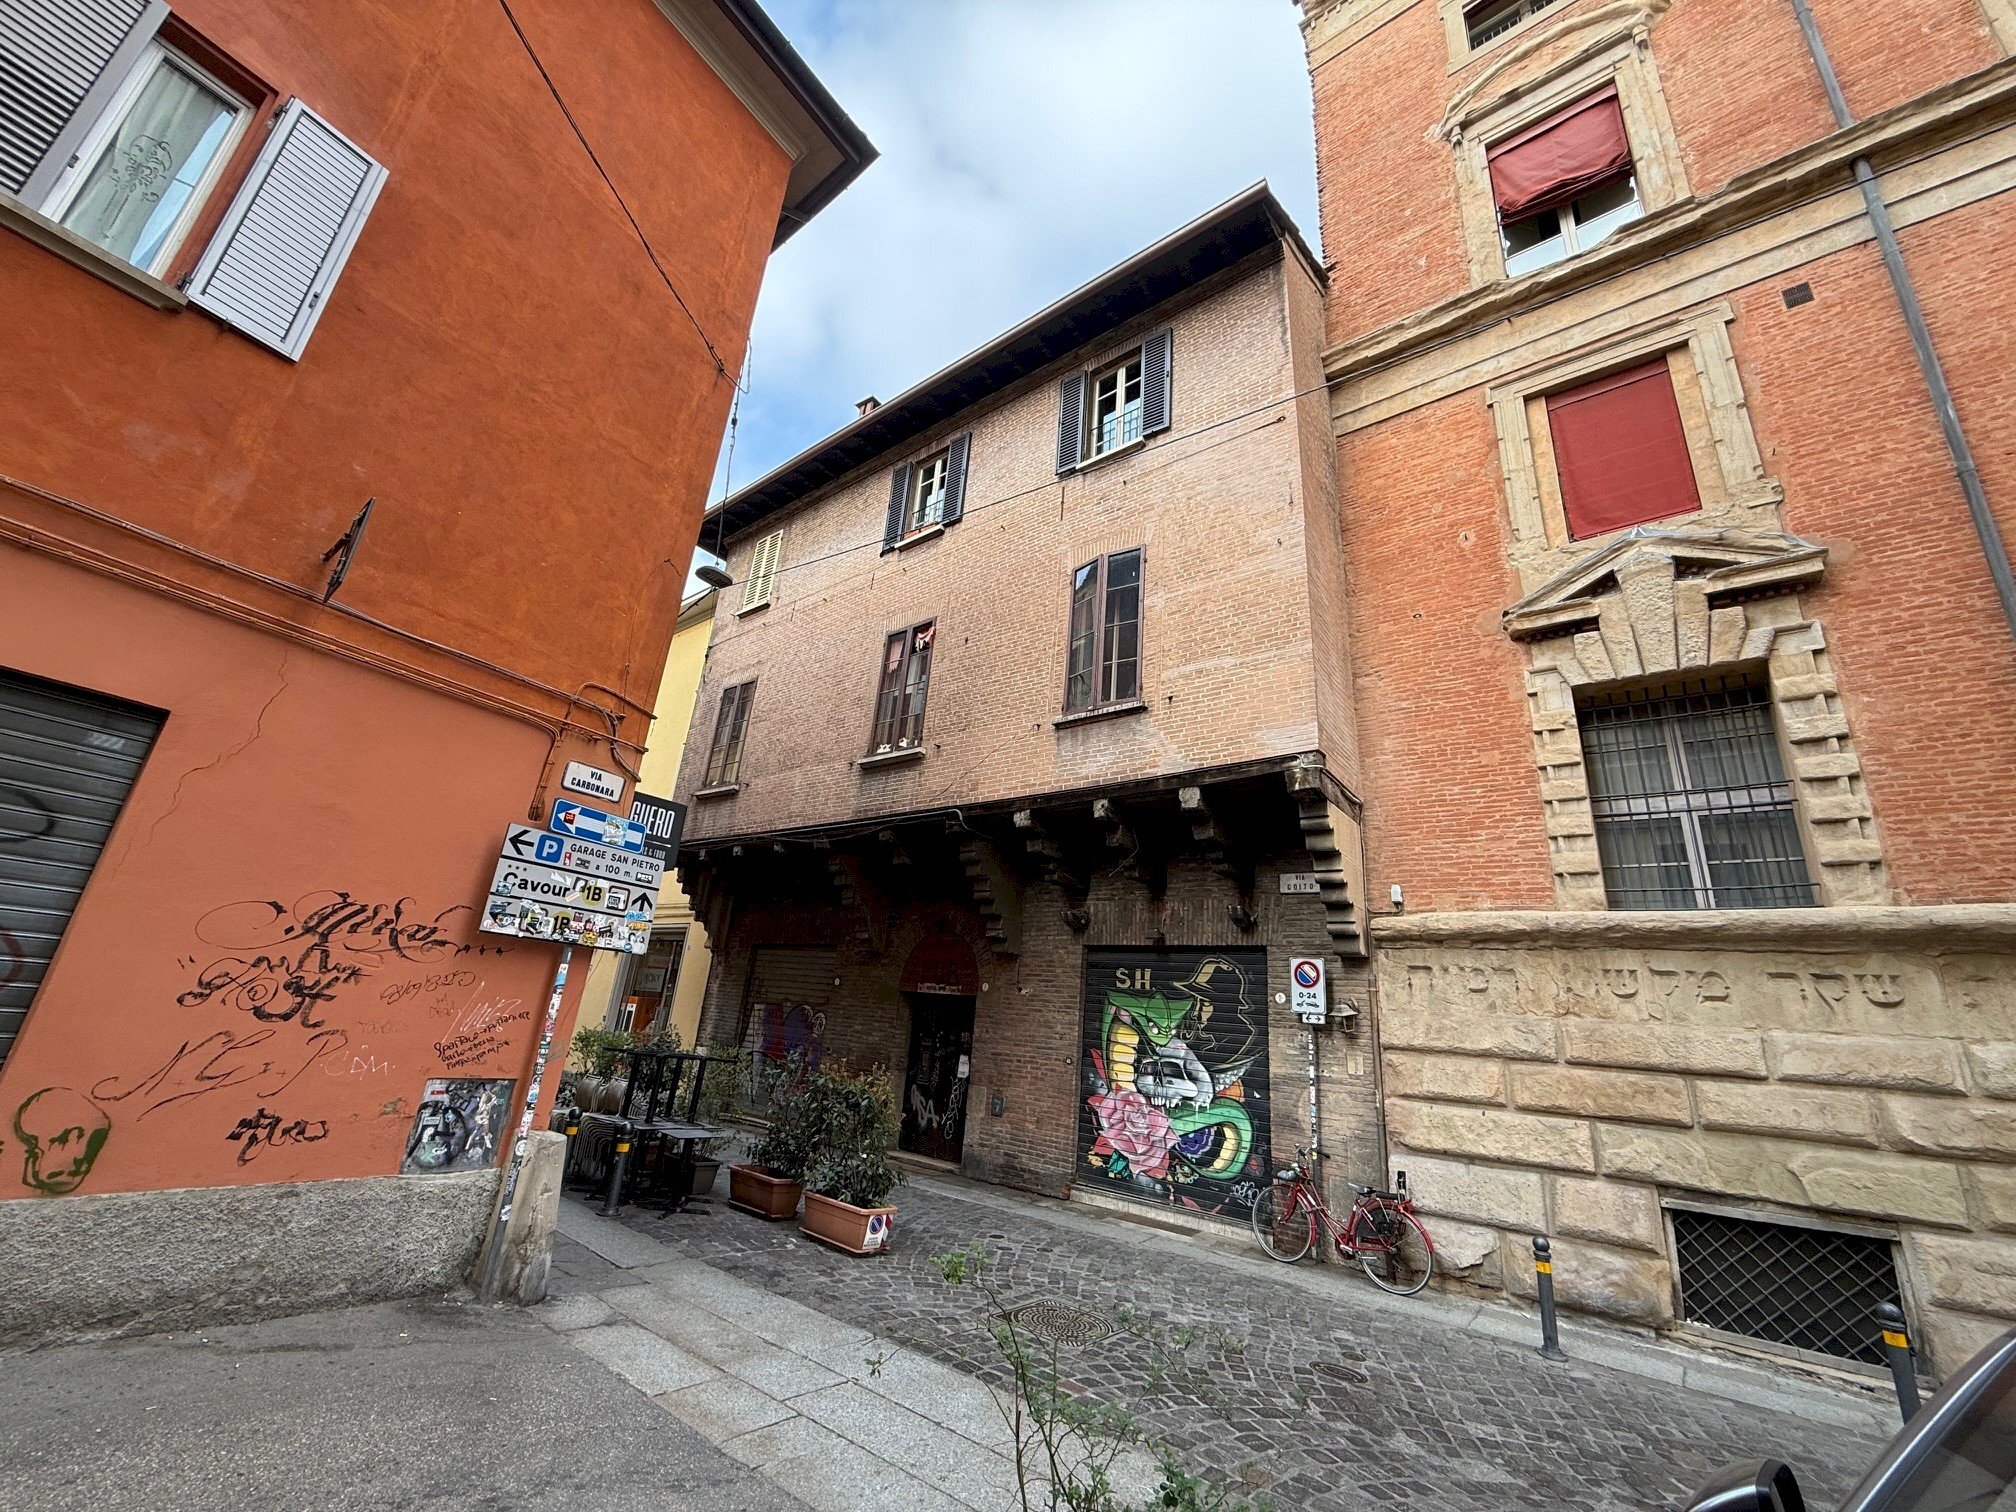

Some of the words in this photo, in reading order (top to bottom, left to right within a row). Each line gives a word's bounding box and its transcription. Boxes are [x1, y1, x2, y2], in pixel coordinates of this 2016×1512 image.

[590, 770, 602, 782] VIA
[570, 777, 615, 798] CARBONARA
[541, 840, 559, 858] P
[570, 843, 607, 860] GARAGE
[610, 853, 629, 865] SAN
[631, 858, 660, 872] PIETRO
[605, 864, 620, 875] 100
[503, 872, 571, 897] Cavour
[586, 885, 602, 901] 1B
